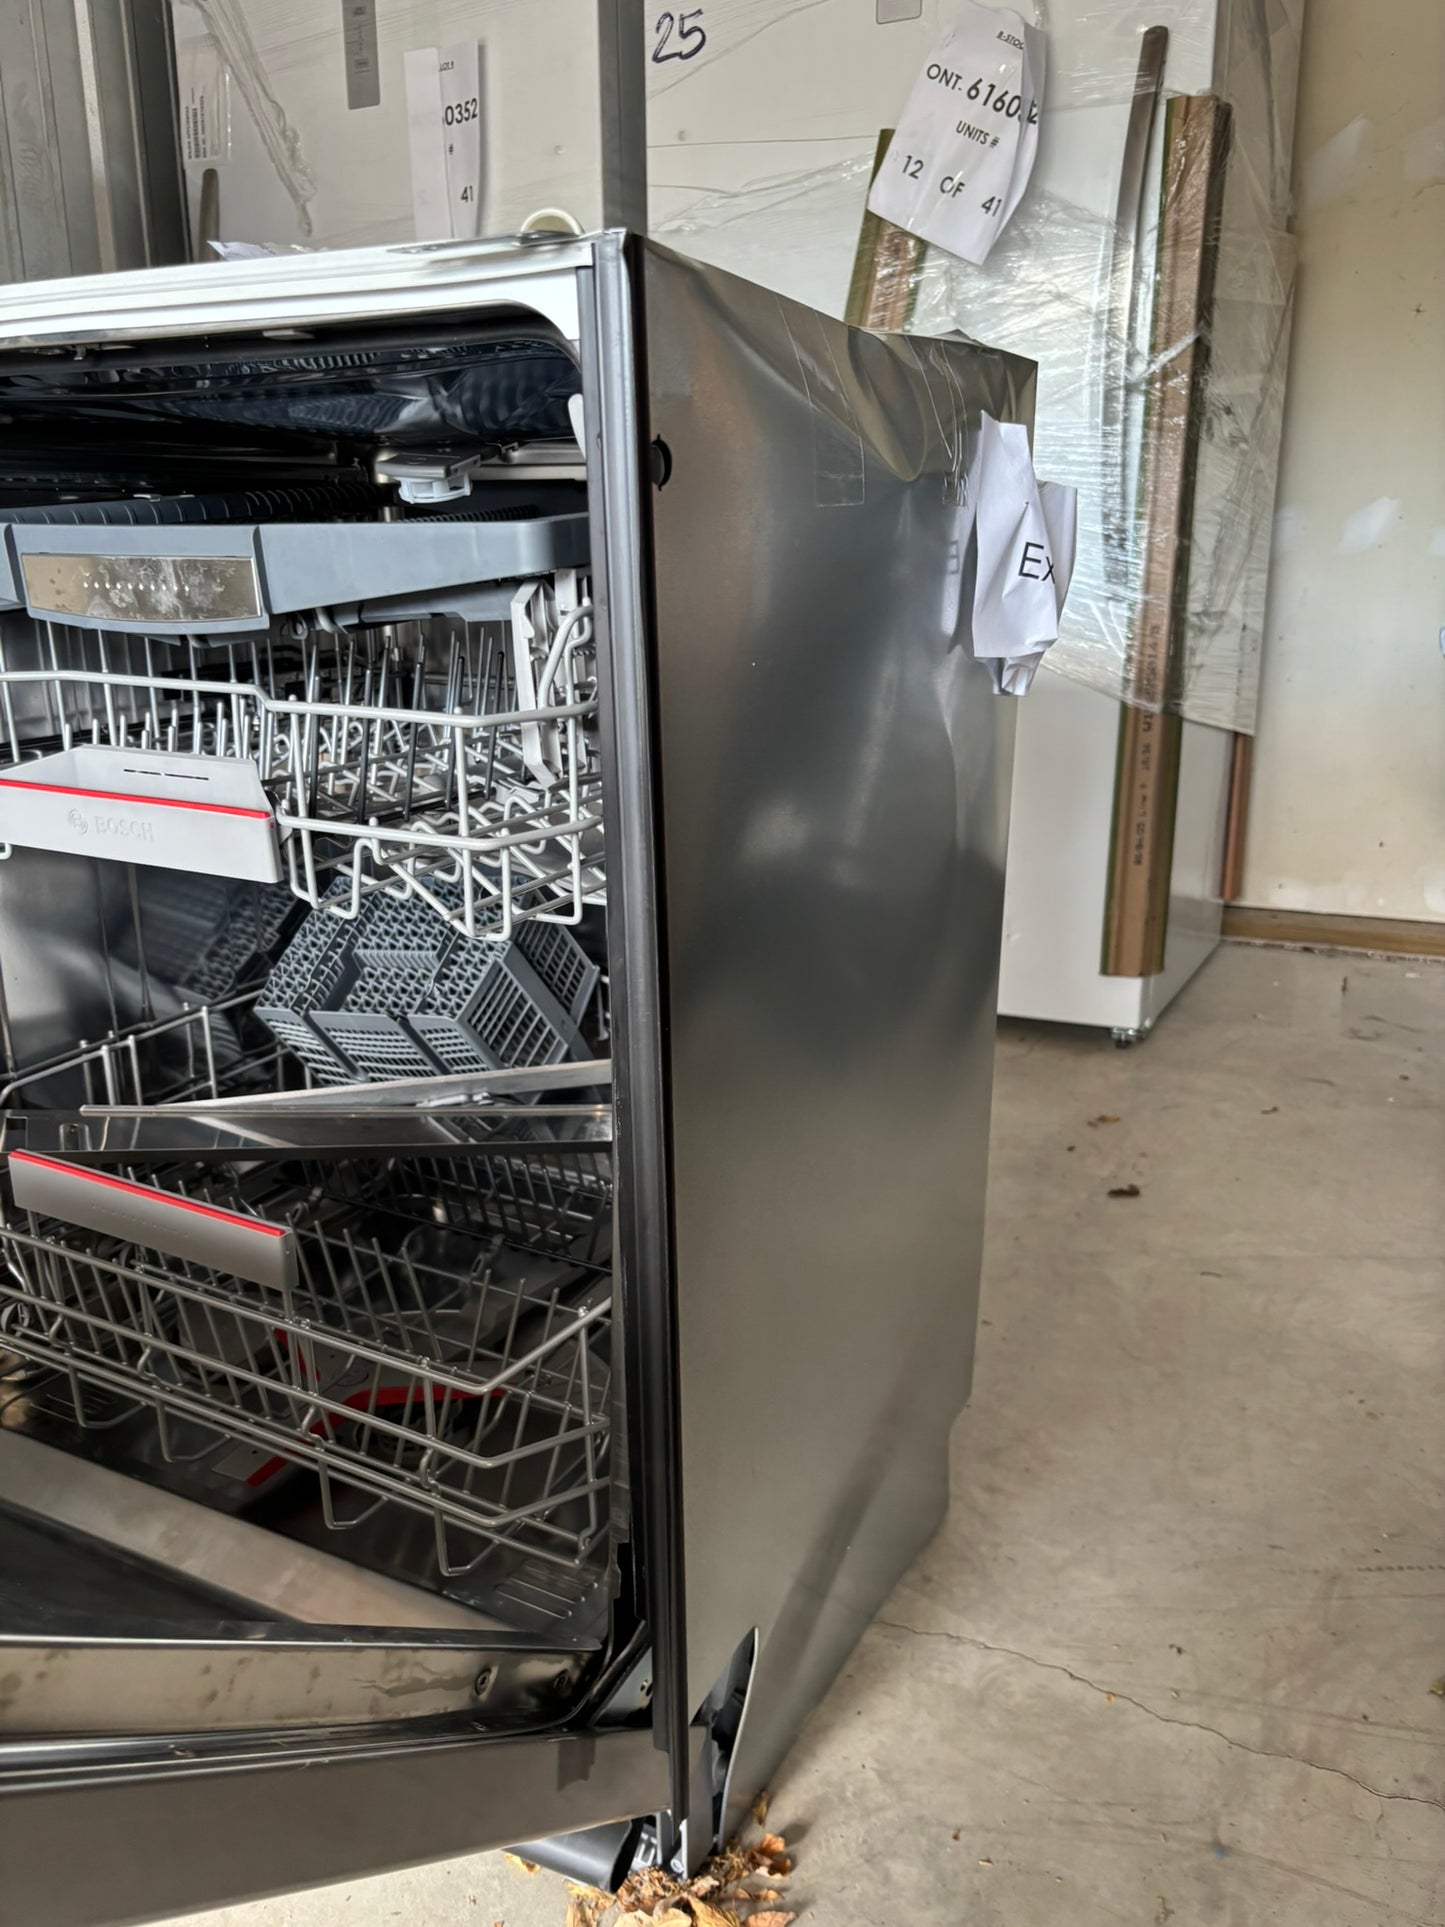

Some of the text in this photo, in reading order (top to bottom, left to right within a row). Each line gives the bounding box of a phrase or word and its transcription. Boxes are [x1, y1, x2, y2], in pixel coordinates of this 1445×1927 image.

[652, 8, 706, 63] 25
[444, 98, 478, 126] 0352
[956, 120, 1000, 148] UNITS #
[461, 185, 474, 202] 41
[902, 155, 1002, 217] 12 OF 41
[94, 815, 154, 842] BOSCH
